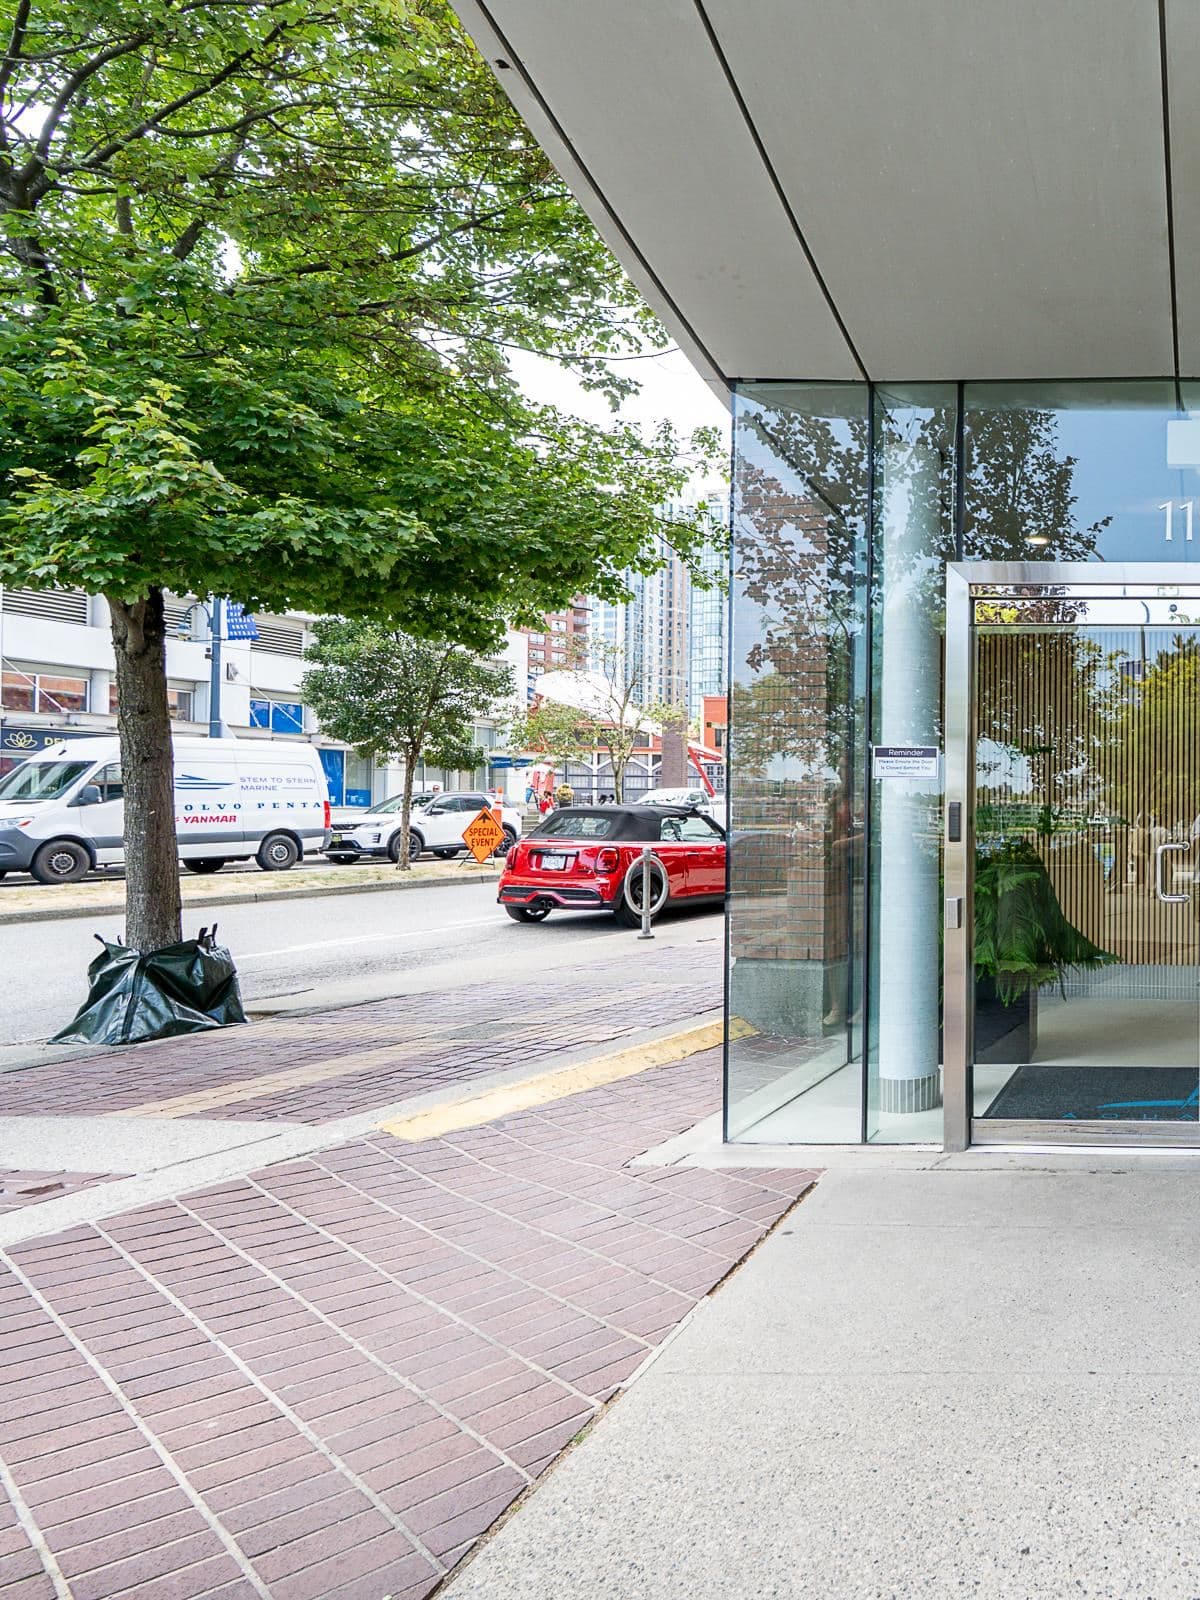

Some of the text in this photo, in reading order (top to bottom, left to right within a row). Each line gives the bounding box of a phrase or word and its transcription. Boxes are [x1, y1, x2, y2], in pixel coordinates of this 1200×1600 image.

[888, 749, 924, 757] Reminder
[239, 776, 268, 784] STEM
[184, 803, 242, 811] OLVO
[183, 815, 238, 824] YANMAR
[469, 827, 498, 837] SPECIAL
[471, 838, 494, 847] EVENT
